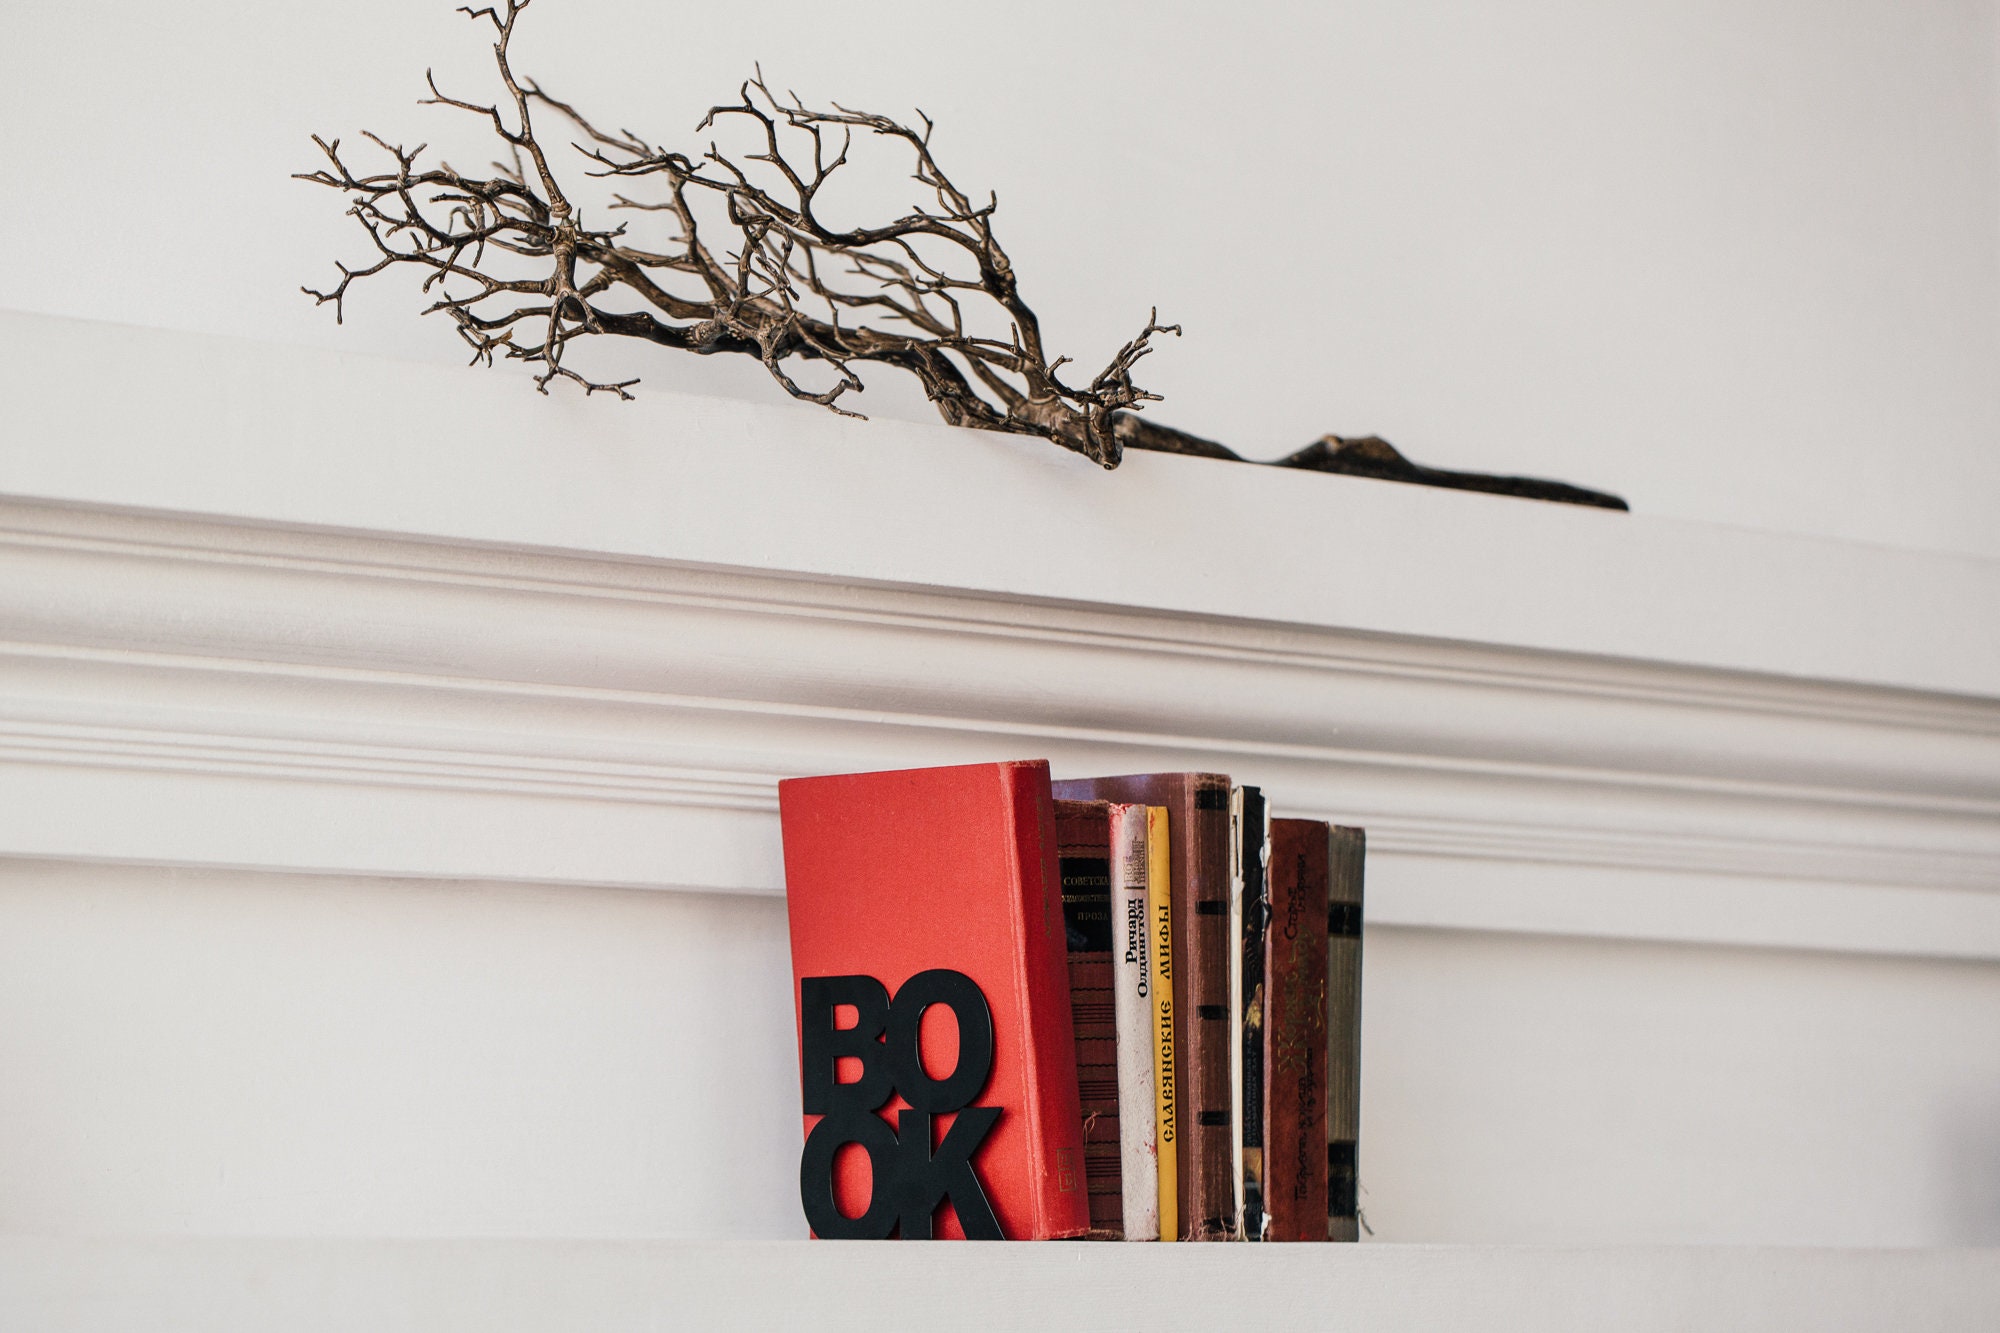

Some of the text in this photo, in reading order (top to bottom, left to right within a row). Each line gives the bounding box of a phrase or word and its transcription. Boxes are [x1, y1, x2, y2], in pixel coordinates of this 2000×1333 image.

[1063, 876, 1109, 886] СОВЕТСКА
[1077, 912, 1108, 920] ПРОЗА
[1125, 899, 1138, 964] Ричард
[1137, 898, 1148, 998] Олдингтон
